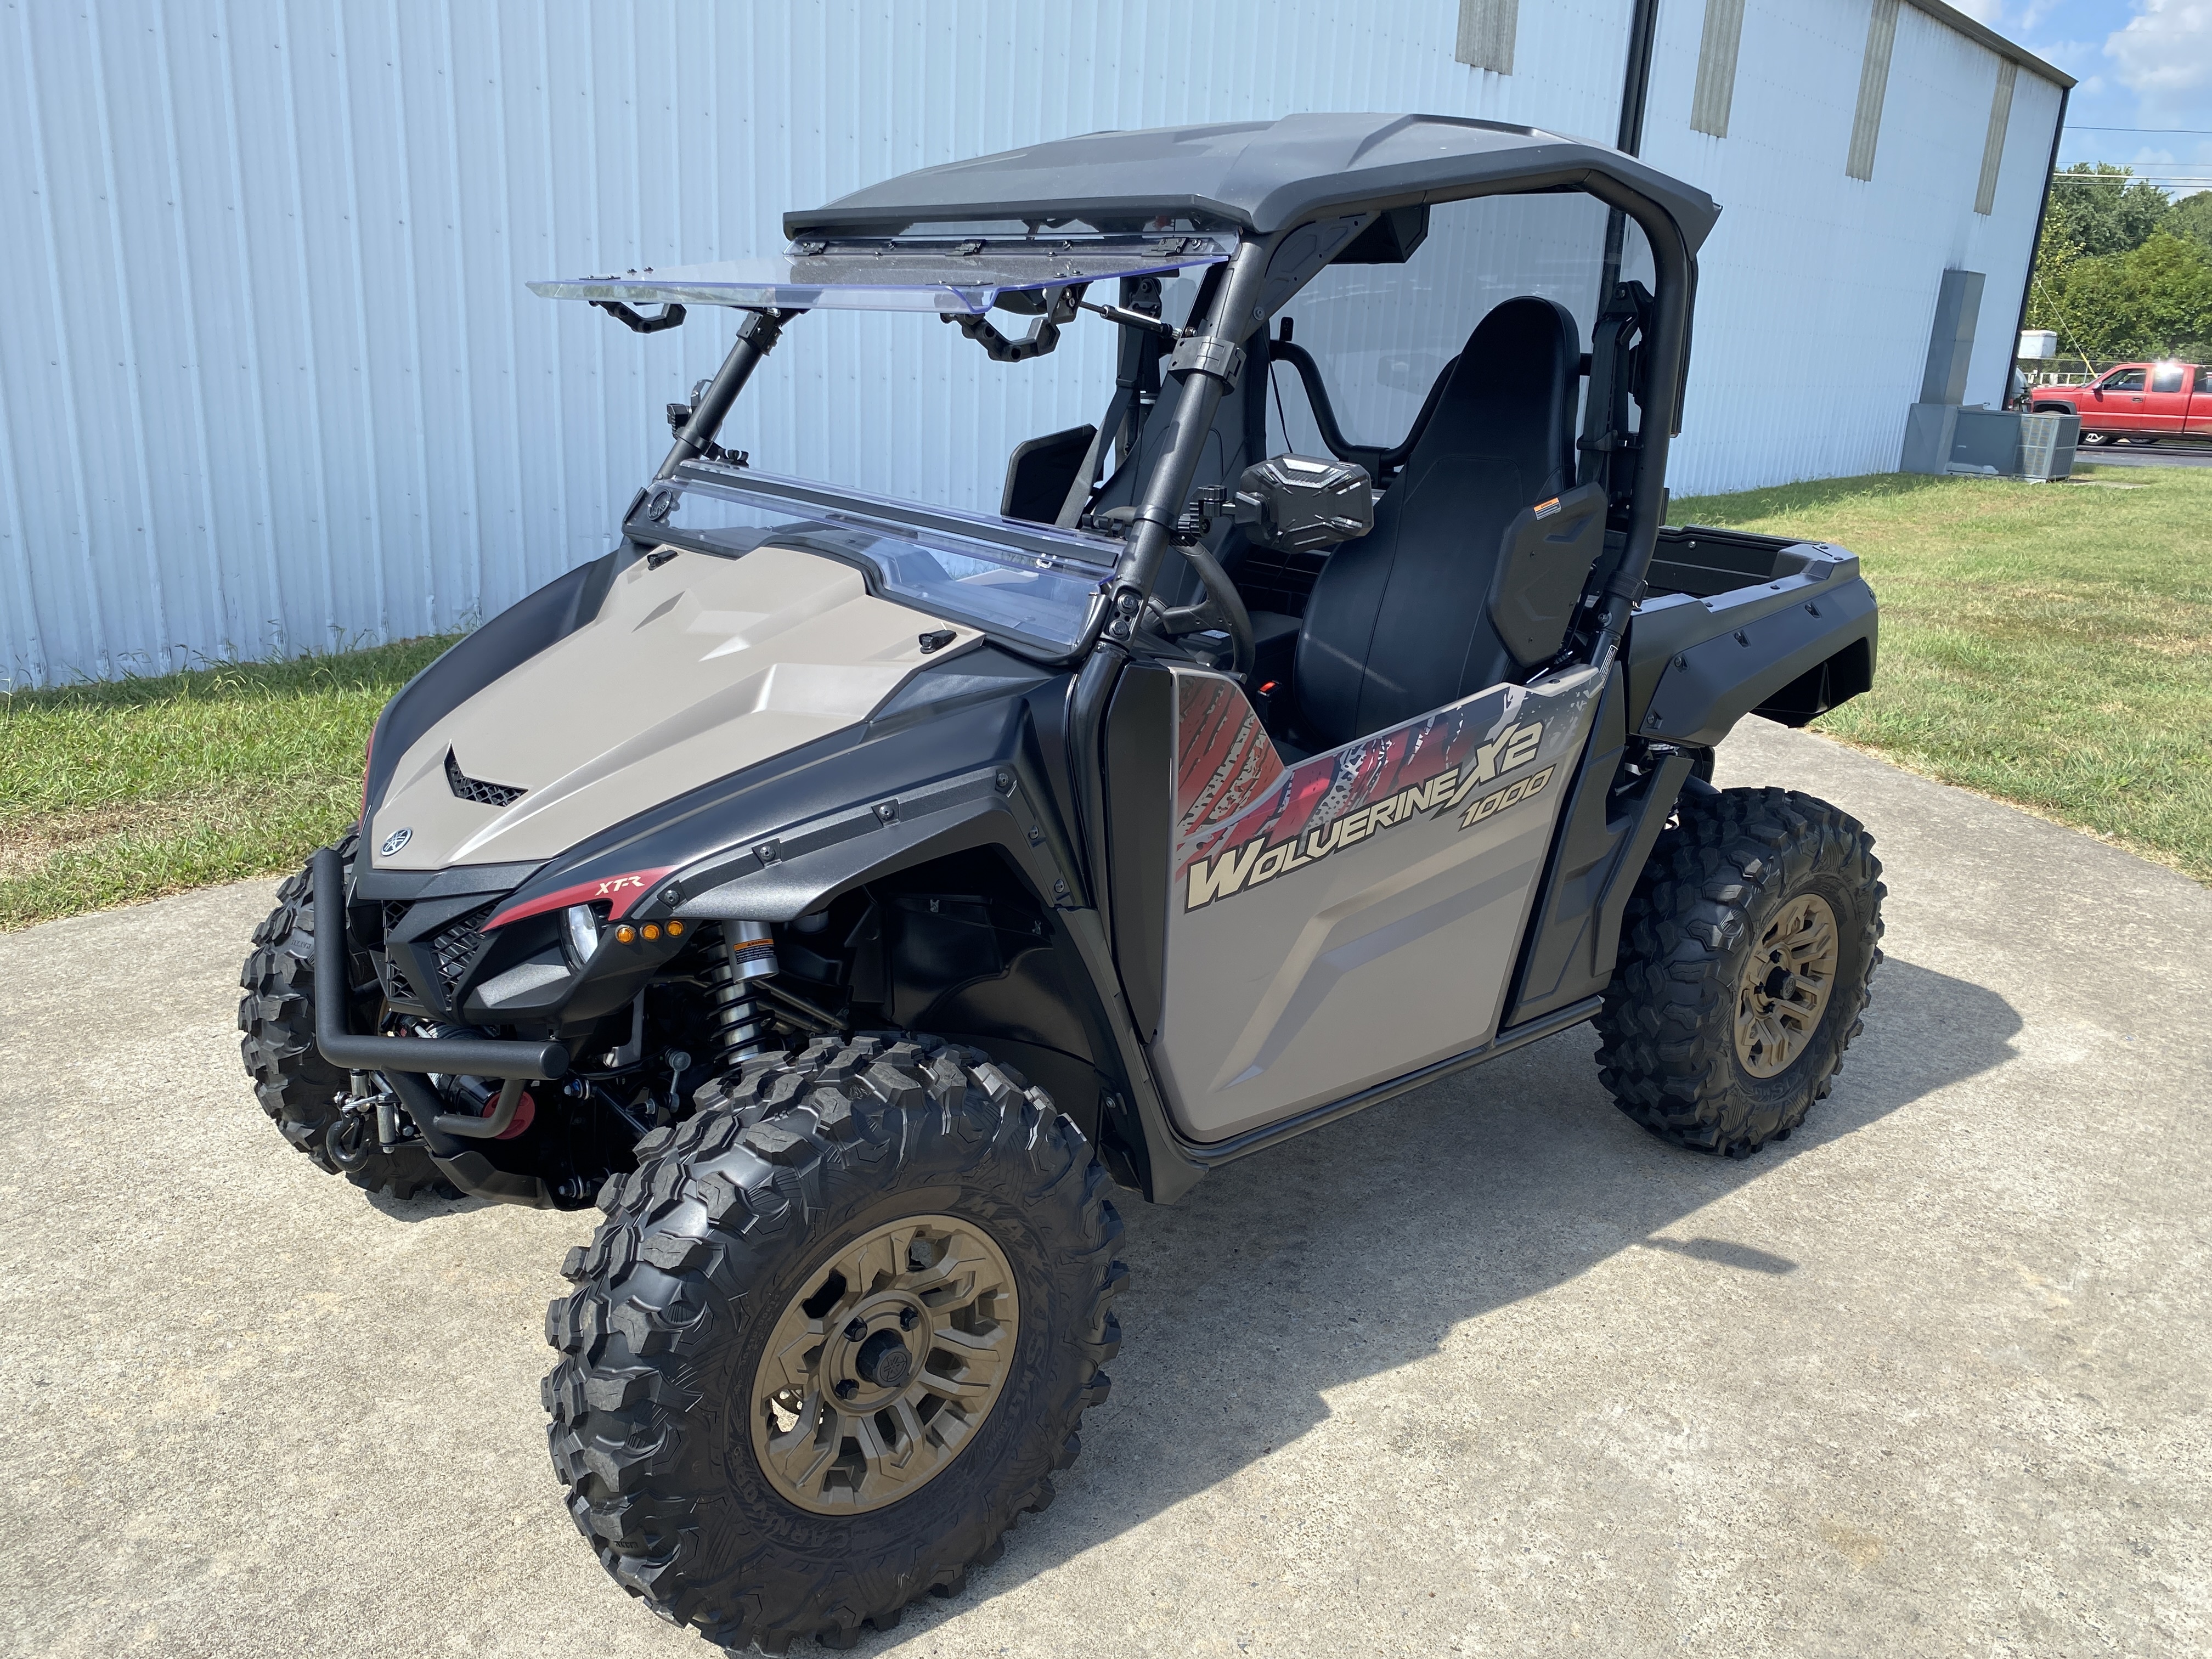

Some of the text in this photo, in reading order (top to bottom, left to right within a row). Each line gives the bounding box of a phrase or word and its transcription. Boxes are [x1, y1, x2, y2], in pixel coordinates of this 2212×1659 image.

[1186, 721, 1545, 910] WOLVERINE X2
[1461, 766, 1556, 830] 1000
[963, 1192, 1049, 1364] MAXXIS
[730, 1446, 849, 1549] CARNIVORE
